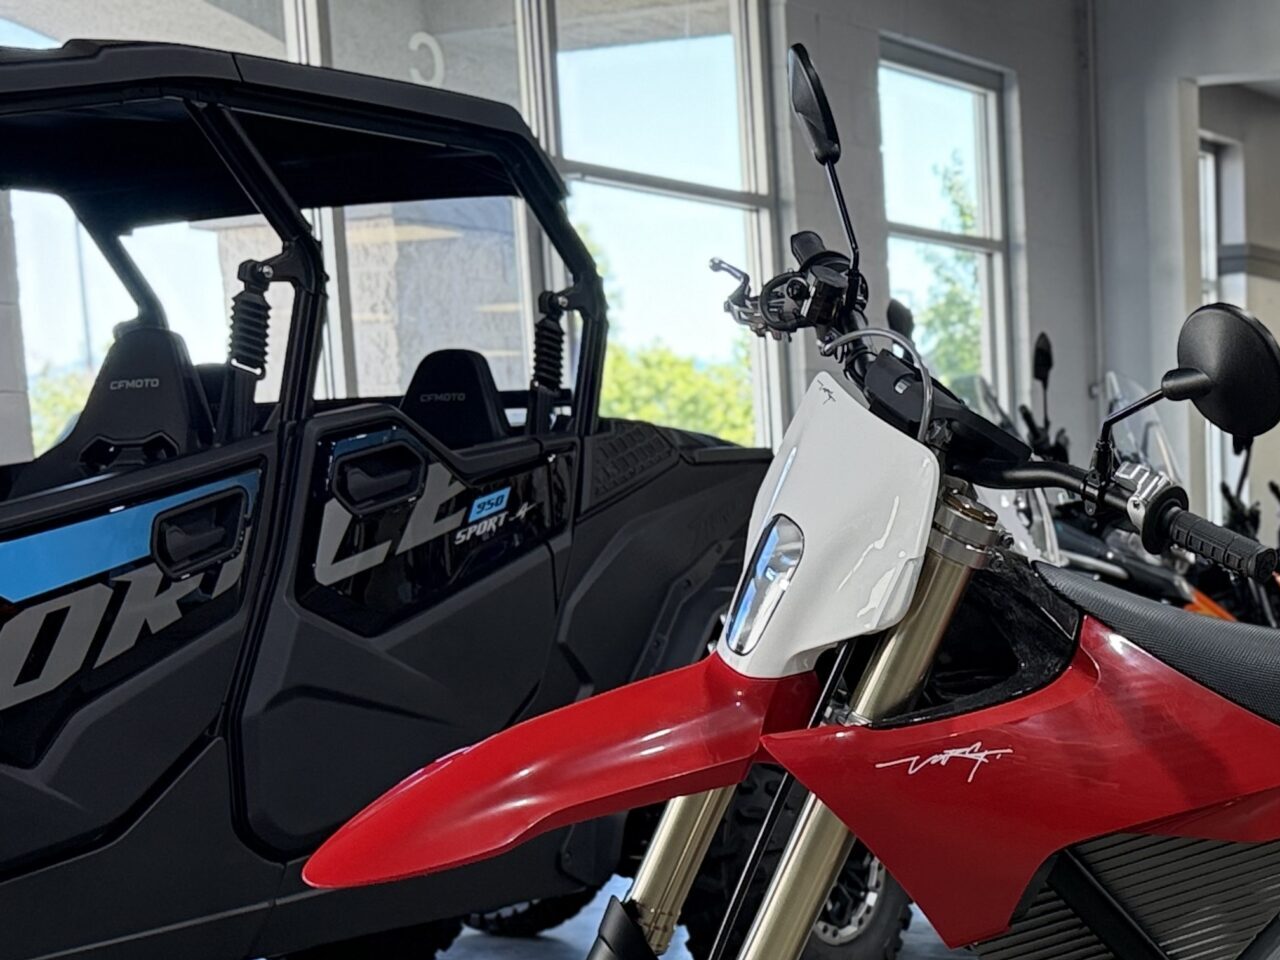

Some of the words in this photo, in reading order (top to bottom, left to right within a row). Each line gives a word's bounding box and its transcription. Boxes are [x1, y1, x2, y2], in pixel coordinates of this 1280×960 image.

[110, 378, 160, 390] CFMOTO
[420, 392, 466, 402] CFMOTO
[476, 494, 506, 515] 950
